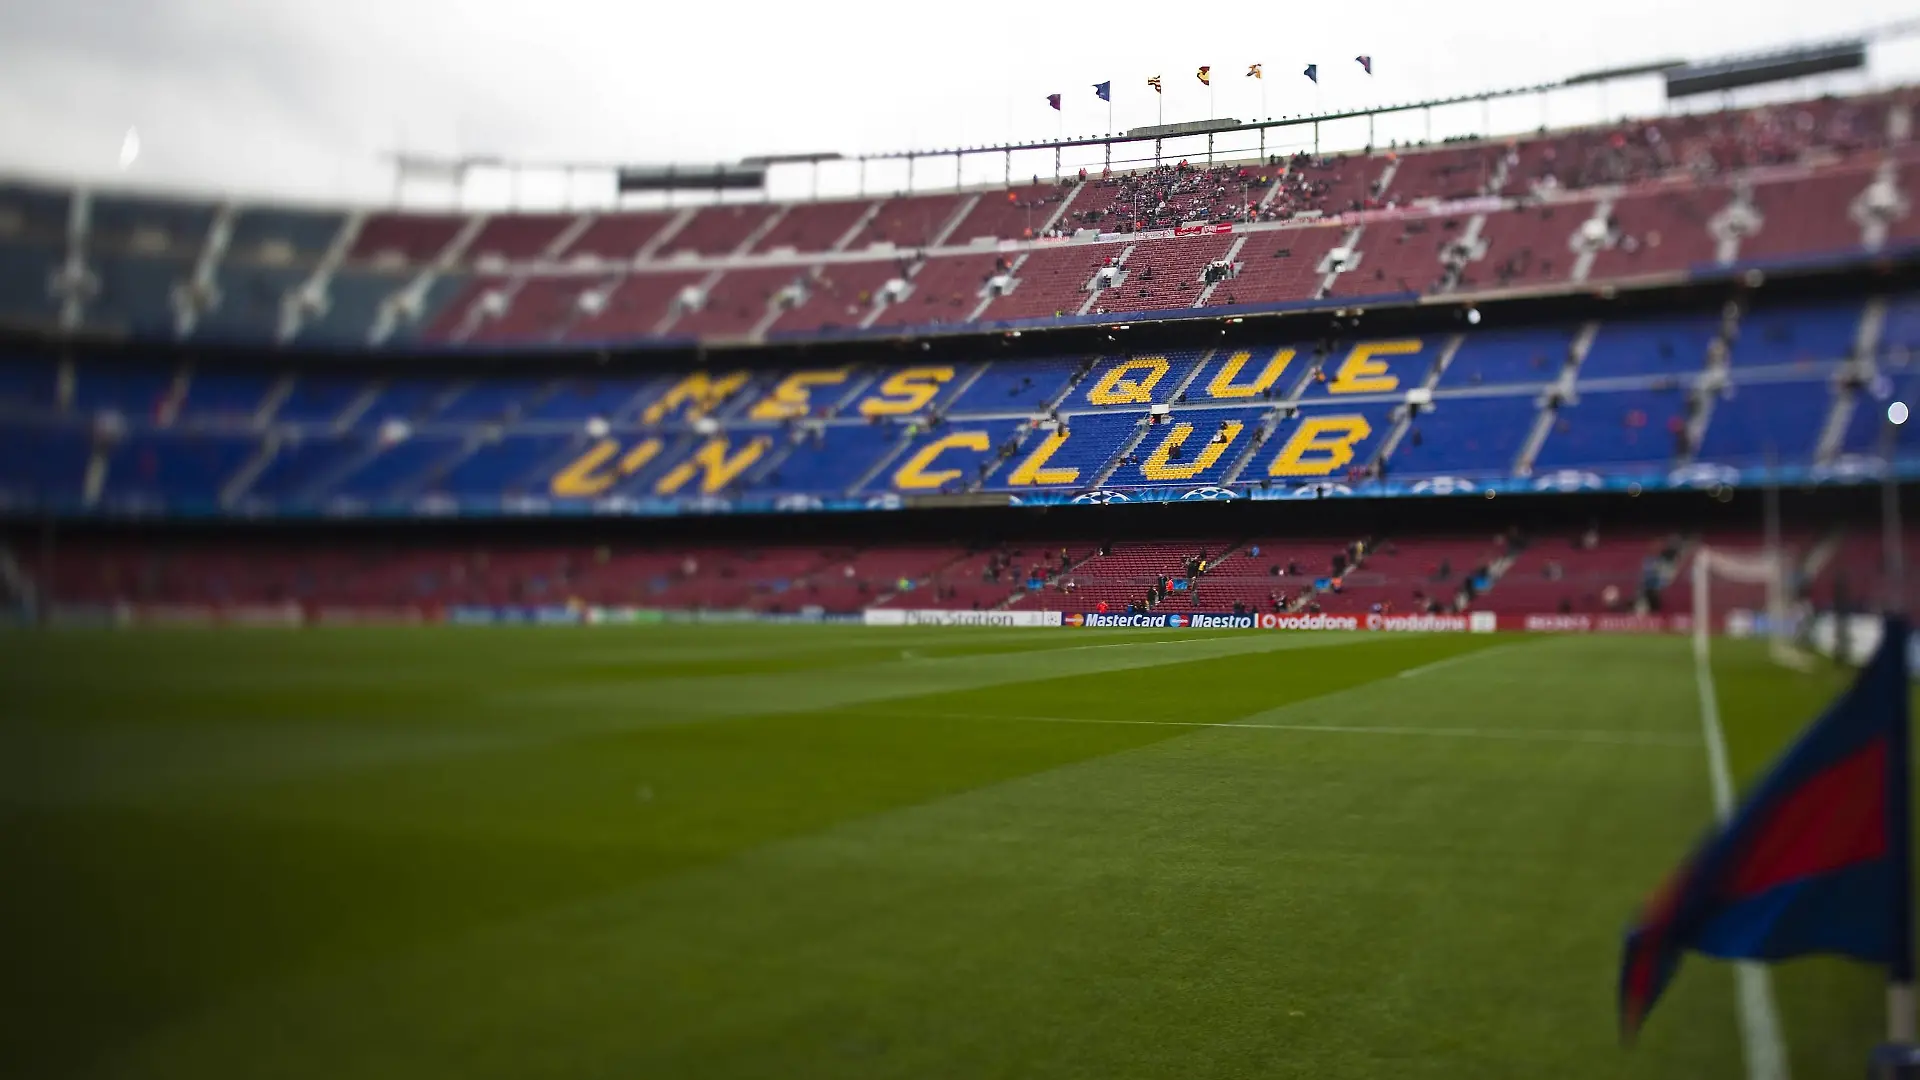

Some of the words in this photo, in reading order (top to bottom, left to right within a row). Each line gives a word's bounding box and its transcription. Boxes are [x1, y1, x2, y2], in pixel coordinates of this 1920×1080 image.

[641, 367, 954, 425] MES
[1088, 339, 1423, 405] QUE
[553, 440, 767, 494] UN
[896, 416, 1371, 488] CLUB
[1085, 613, 1166, 627] MasterCard
[1191, 614, 1251, 628] Maestro
[1277, 613, 1357, 629] vodafone
